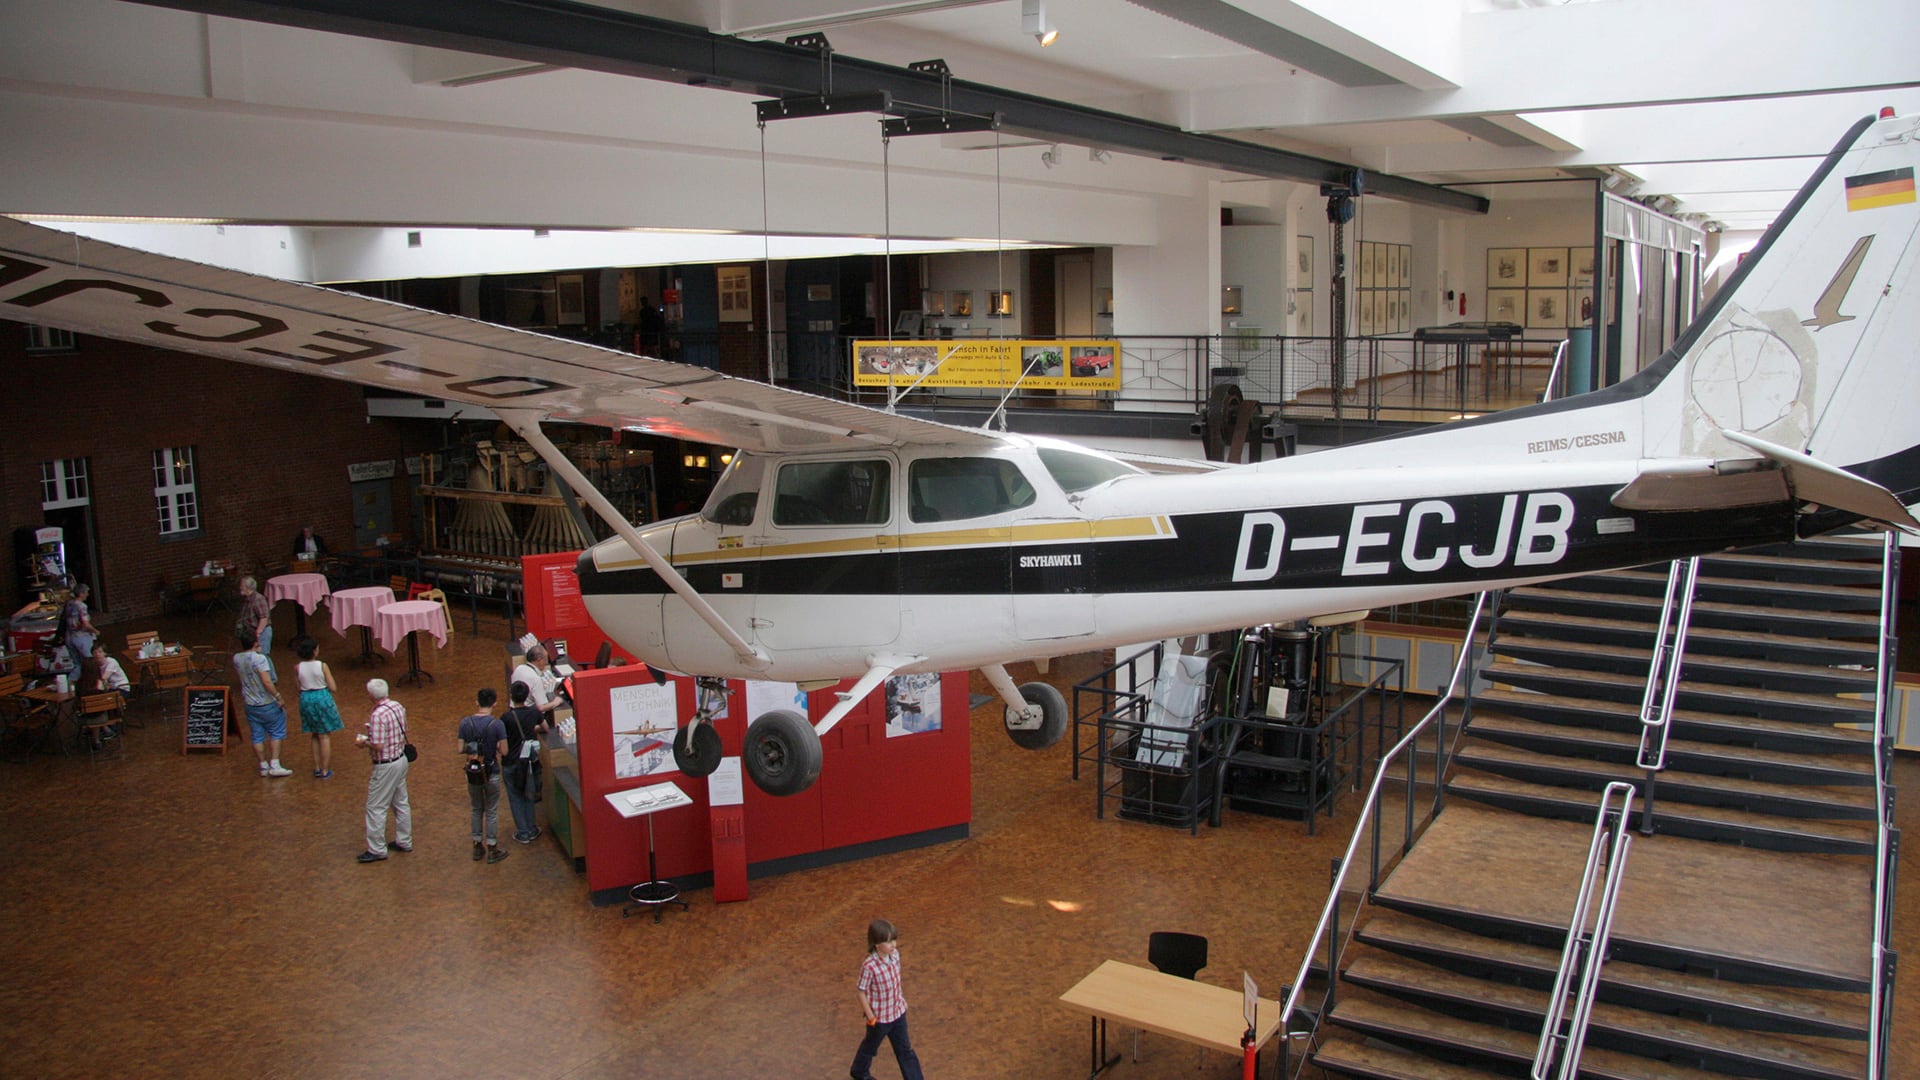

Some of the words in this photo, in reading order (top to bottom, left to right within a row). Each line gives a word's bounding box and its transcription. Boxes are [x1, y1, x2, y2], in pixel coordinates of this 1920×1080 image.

[990, 345, 1011, 353] Fahrt
[1527, 430, 1627, 455] REIMS/CESSNA
[1231, 491, 1575, 583] D-ECJB
[1019, 554, 1073, 568] SKYHAWK
[1073, 553, 1082, 566] II
